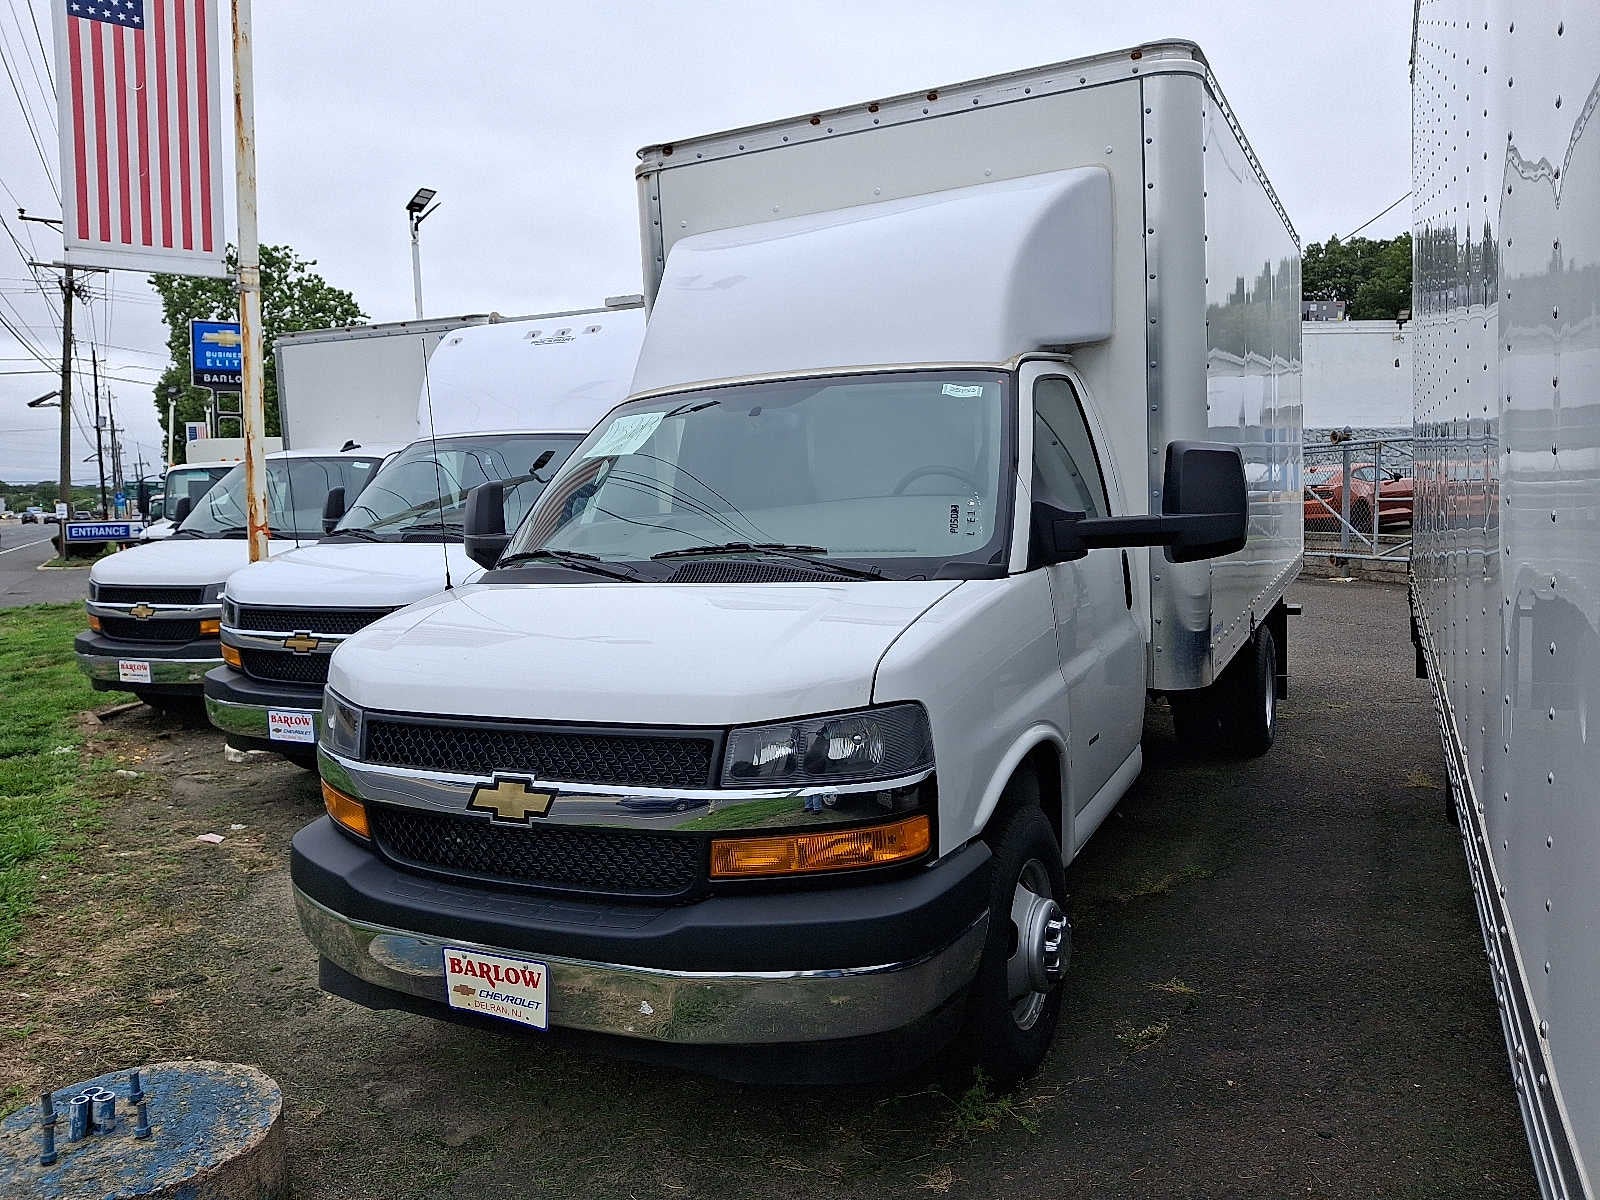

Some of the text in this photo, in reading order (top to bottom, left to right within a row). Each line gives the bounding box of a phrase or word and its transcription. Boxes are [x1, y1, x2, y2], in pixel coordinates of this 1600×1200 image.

[71, 527, 127, 537] ENTRANCE
[271, 715, 311, 728] BARLOW
[449, 957, 542, 989] BARLOW
[479, 990, 542, 1010] CHEVROLET
[511, 1009, 522, 1018] NJ
